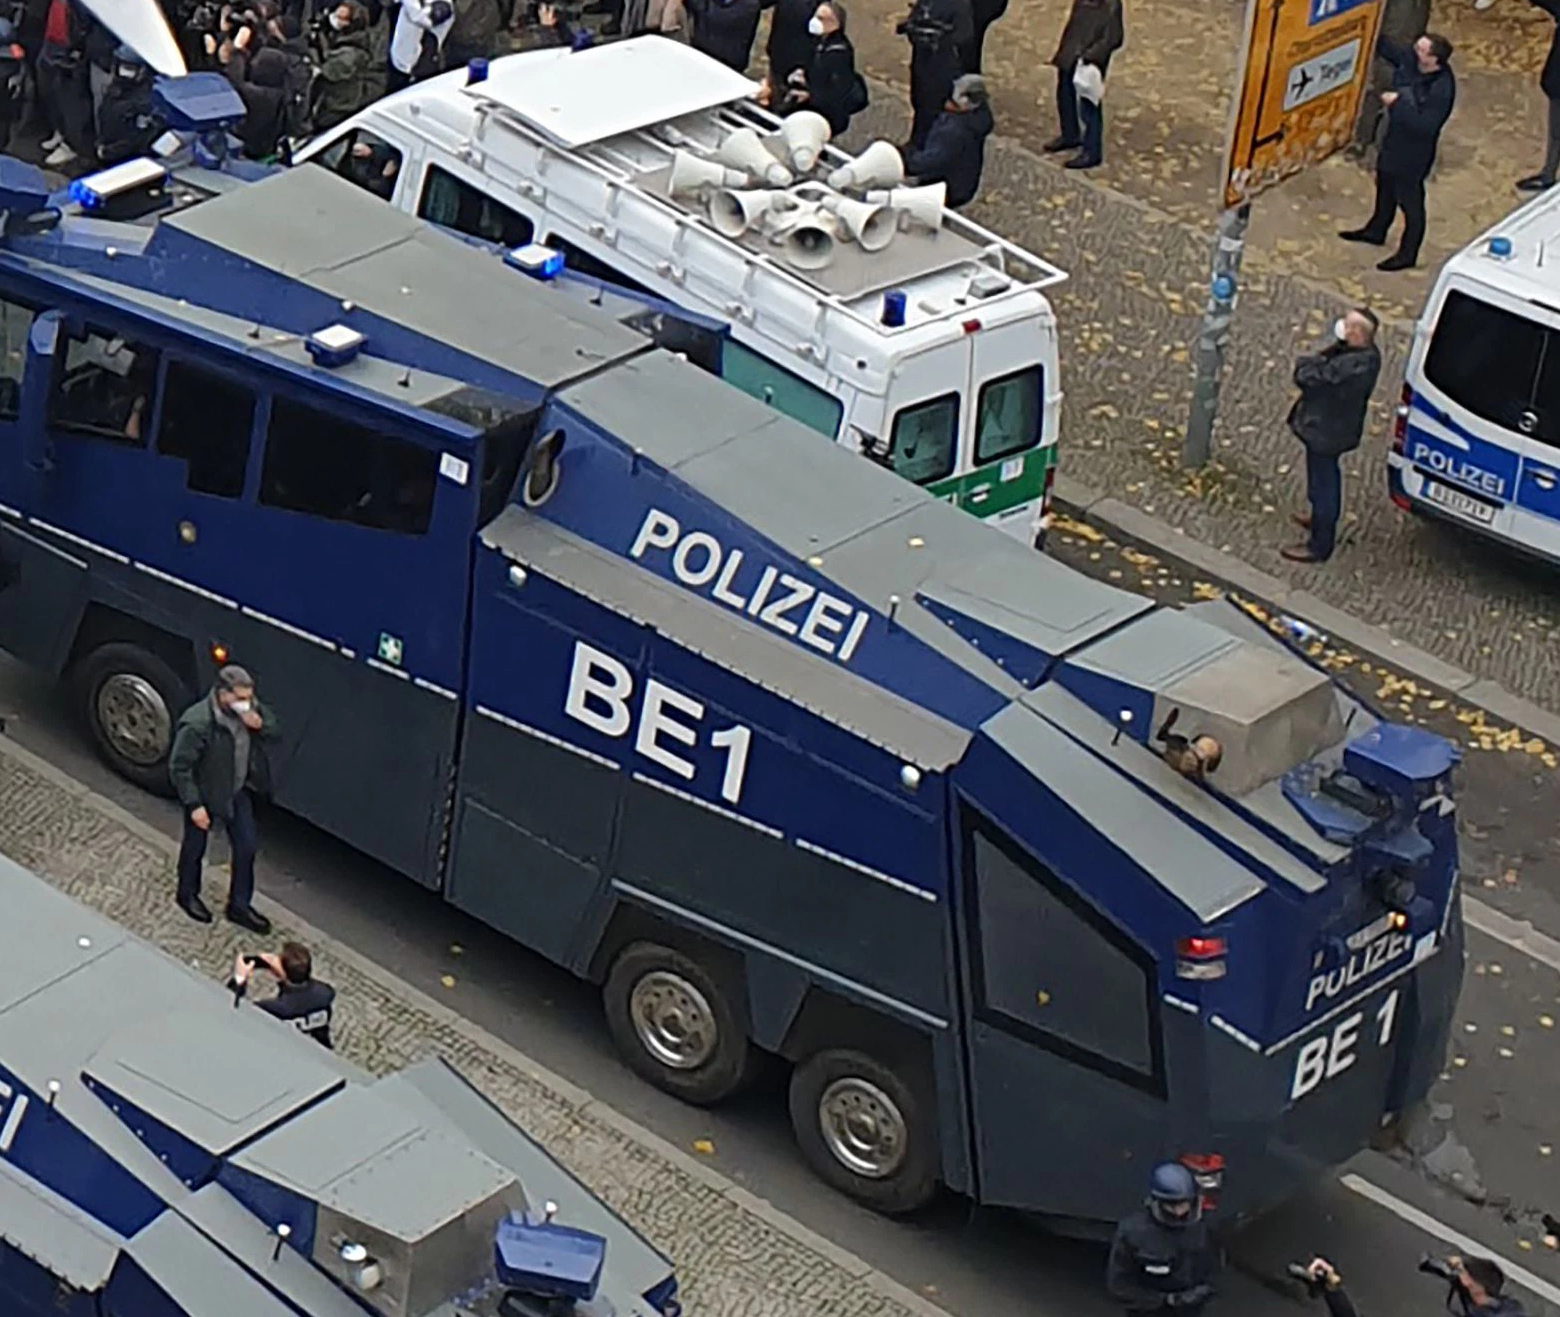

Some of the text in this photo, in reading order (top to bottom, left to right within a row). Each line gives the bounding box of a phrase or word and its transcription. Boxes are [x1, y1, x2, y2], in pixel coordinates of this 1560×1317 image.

[1414, 442, 1506, 495] POLIZEI
[630, 508, 869, 662] POLIZEI
[564, 640, 751, 804] BE1
[1291, 989, 1399, 1100] BE 1
